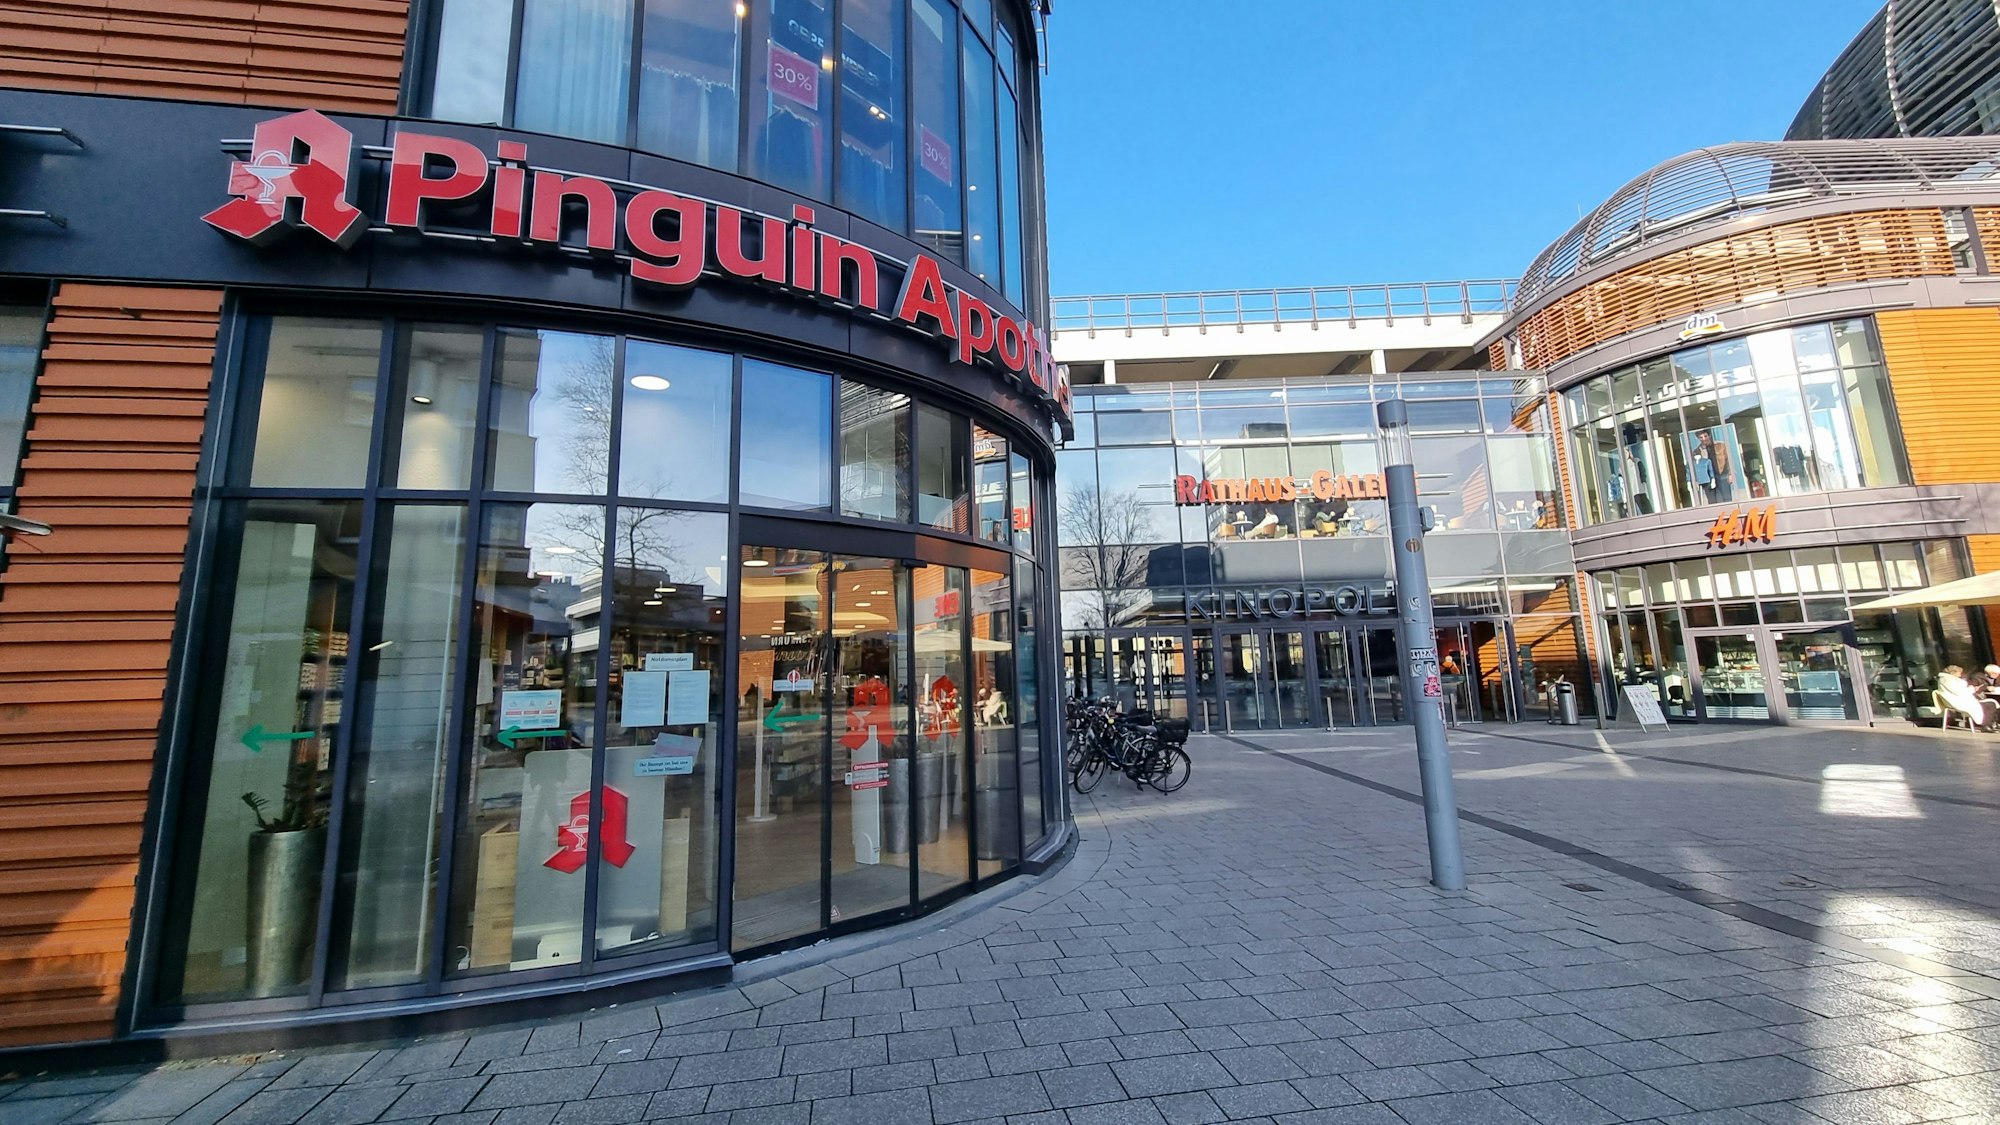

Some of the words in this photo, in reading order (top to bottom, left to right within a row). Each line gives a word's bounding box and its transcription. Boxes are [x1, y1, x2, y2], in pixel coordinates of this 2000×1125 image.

[774, 62, 813, 91] 30%
[923, 143, 949, 170] 30%
[385, 132, 878, 310] Pinguin
[1176, 470, 1420, 504] RATHAUS-GALE
[1708, 504, 1777, 546] H&M
[1185, 585, 1390, 620] KINOPOL
